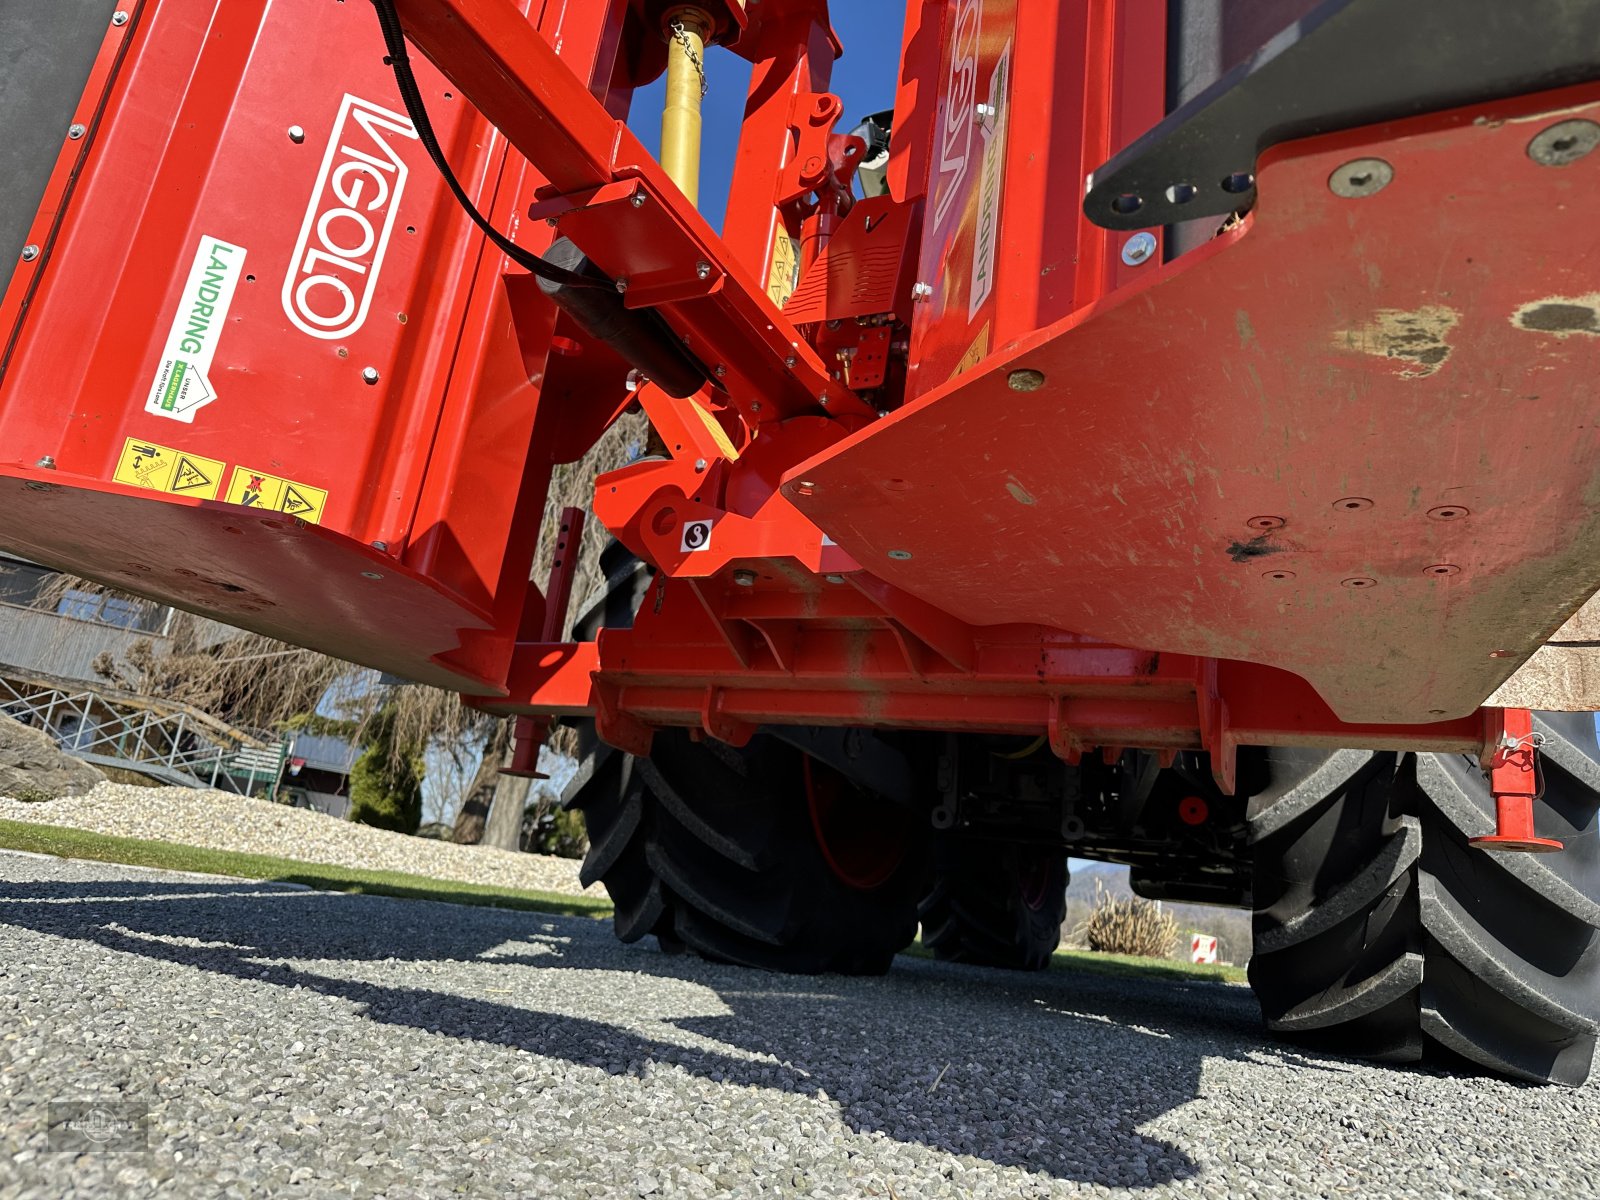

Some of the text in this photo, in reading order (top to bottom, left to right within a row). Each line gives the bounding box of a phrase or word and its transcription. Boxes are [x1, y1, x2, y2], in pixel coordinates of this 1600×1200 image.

[285, 92, 419, 336] VIGOLO
[975, 135, 998, 307] LANDRING
[179, 243, 233, 354] LANDRING
[166, 369, 182, 408] LAGERHAUS
[180, 378, 191, 400] UNSER
